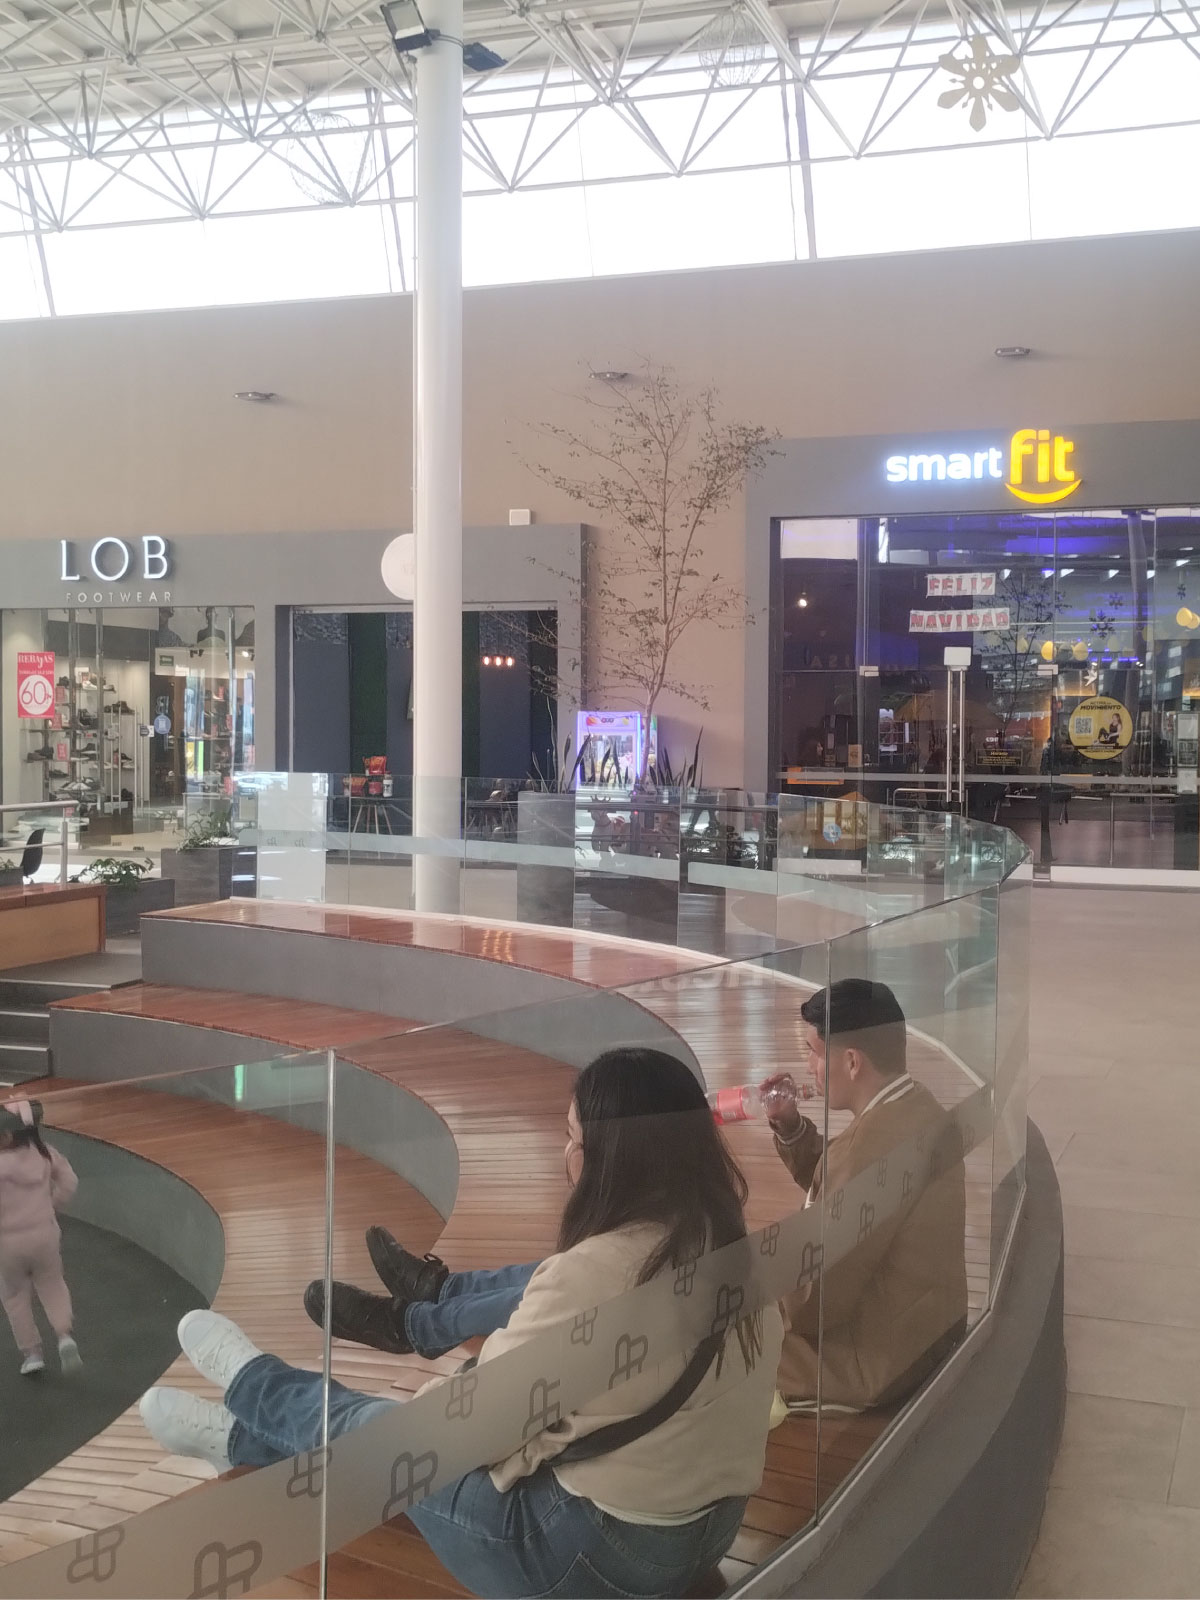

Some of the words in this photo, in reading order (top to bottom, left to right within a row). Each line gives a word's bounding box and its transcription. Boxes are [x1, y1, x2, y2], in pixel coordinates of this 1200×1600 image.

[886, 446, 1003, 483] smart
[1009, 428, 1075, 486] fit
[60, 535, 171, 582] LOB
[928, 576, 994, 593] FELIZ
[65, 591, 172, 603] FOOTWEAR
[910, 612, 1009, 629] NAVIDAD
